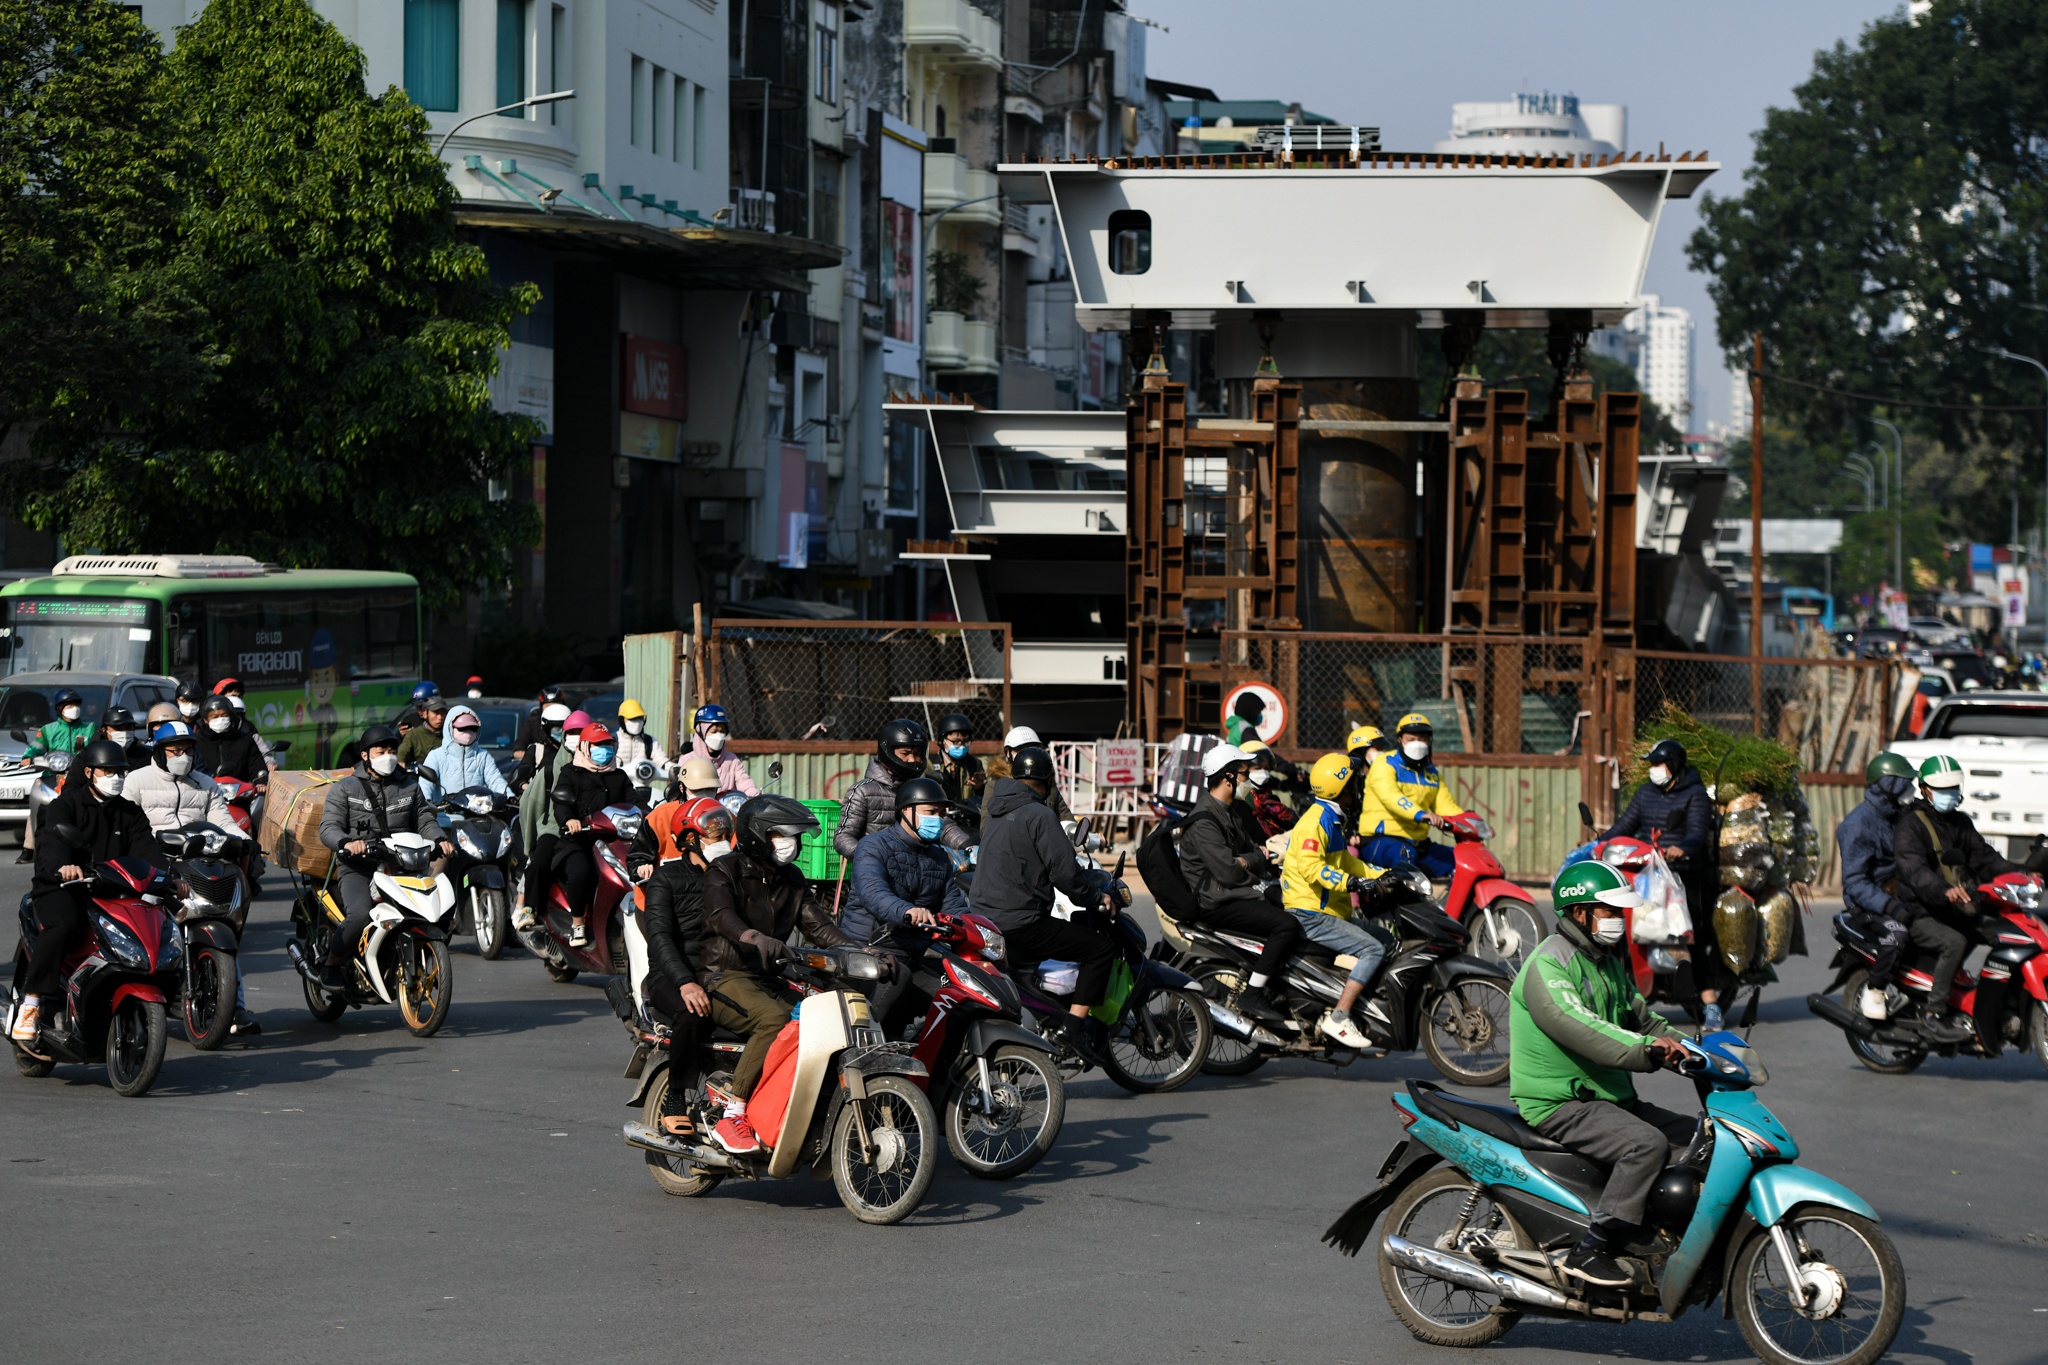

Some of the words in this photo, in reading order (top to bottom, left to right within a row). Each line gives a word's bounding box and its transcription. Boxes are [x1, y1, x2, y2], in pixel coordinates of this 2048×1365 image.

[1518, 89, 1557, 114] THÁI
[649, 358, 669, 400] MSB
[1333, 767, 1349, 780] be
[1559, 883, 1587, 898] Grab
